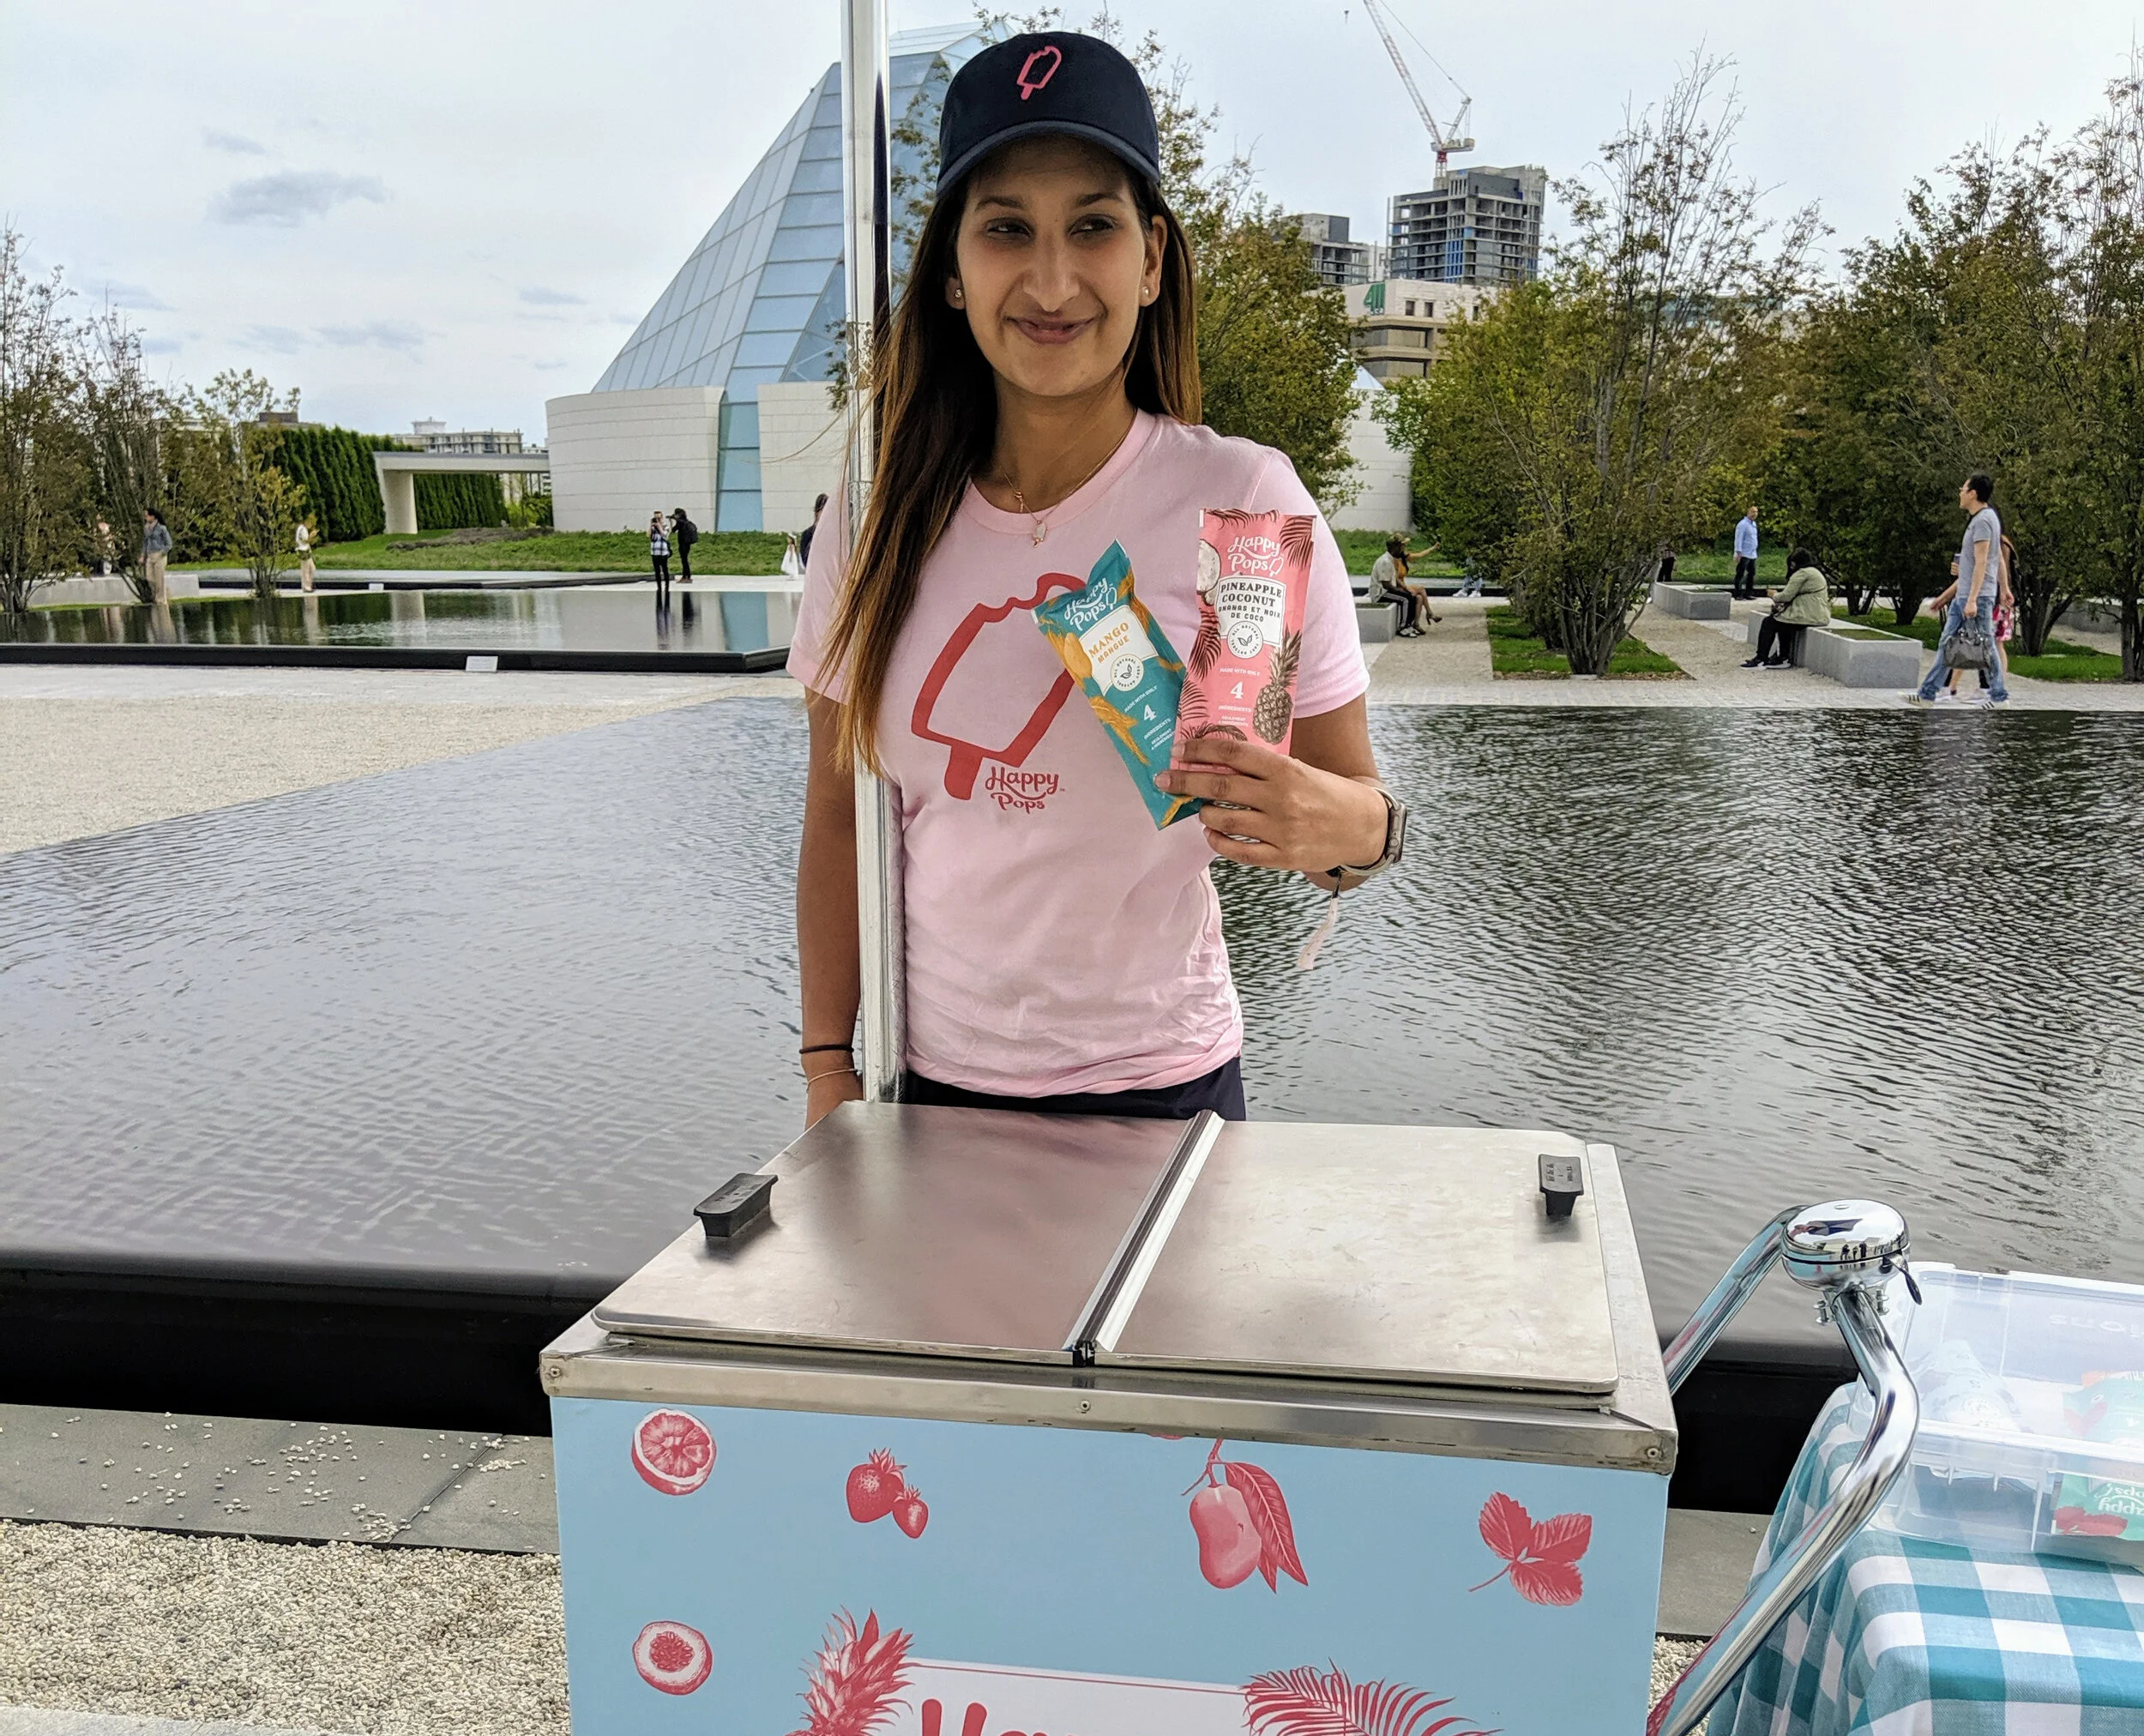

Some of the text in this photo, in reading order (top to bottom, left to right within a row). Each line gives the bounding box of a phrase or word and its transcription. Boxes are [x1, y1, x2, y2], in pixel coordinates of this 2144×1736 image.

[1227, 536, 1280, 559] Happy
[1228, 553, 1268, 574] Pops
[1064, 578, 1108, 620] Happy
[1220, 582, 1282, 598] PINEAPPLE
[1222, 594, 1275, 606] COCONUT
[1070, 601, 1106, 631] Pops
[1244, 613, 1263, 622] COCO
[1264, 609, 1280, 618] NOIX
[1088, 623, 1129, 658] MANGO
[1098, 636, 1129, 663] MANGUE
[1230, 681, 1244, 699] 4
[1144, 704, 1156, 720] 4
[985, 766, 1059, 799] Happy
[991, 793, 1045, 814] Pops
[2114, 1486, 2144, 1498] ops
[2098, 1496, 2144, 1516] appy
